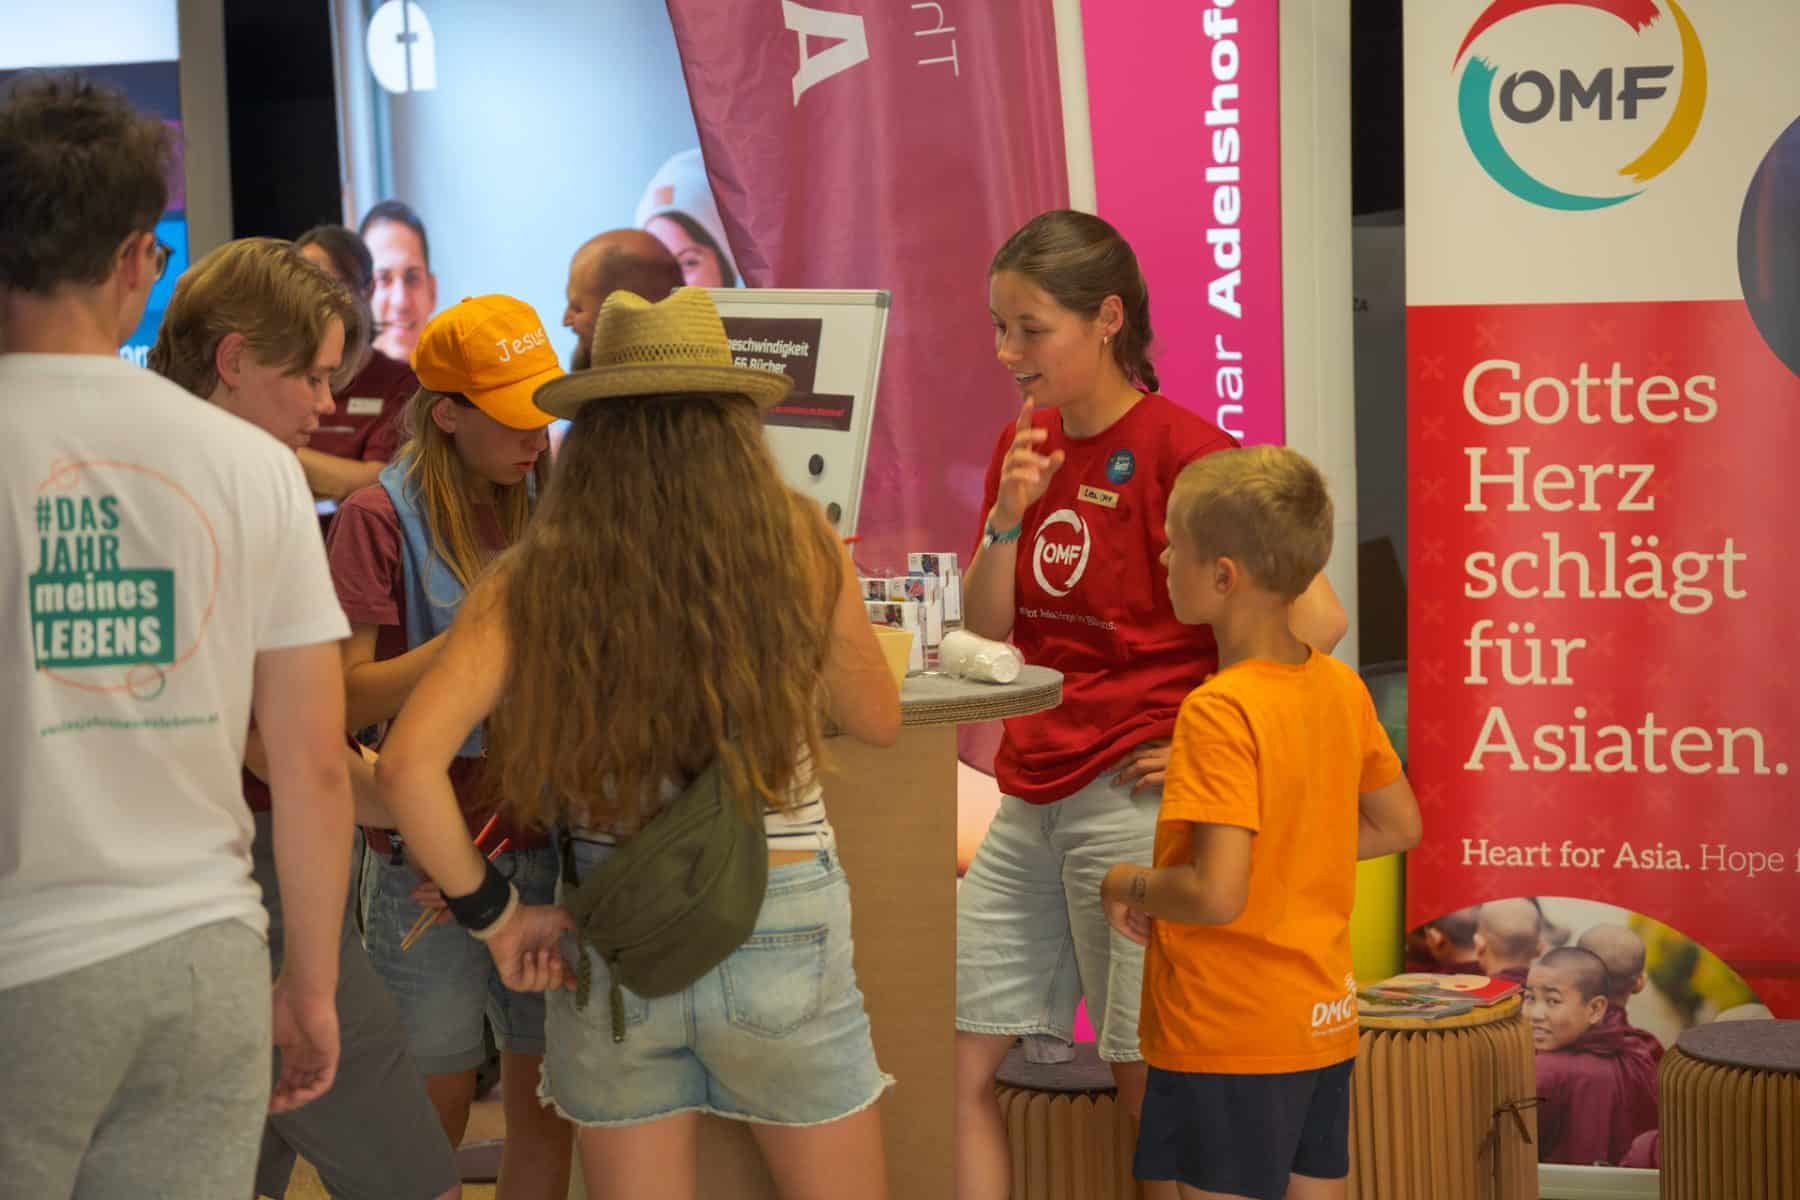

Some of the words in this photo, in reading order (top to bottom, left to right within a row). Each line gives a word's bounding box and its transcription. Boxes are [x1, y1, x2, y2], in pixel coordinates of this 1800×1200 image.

[1500, 65, 1675, 124] OMF
[1203, 0, 1242, 319] Adelshof
[1463, 359, 1718, 425] Gottes
[1463, 446, 1656, 512] Herz
[36, 496, 120, 532] #DAS
[38, 535, 120, 574] JAHR
[1042, 542, 1082, 566] OMF
[1464, 531, 1748, 615] schlägt
[35, 572, 159, 614] meines
[35, 616, 161, 660] LEBENS
[1463, 619, 1587, 685] für
[1463, 706, 1789, 776] Asiaten.
[1461, 838, 1553, 867] Heart
[1559, 840, 1605, 869] for
[1613, 841, 1691, 871] Asia.
[1699, 843, 1785, 878] Hope
